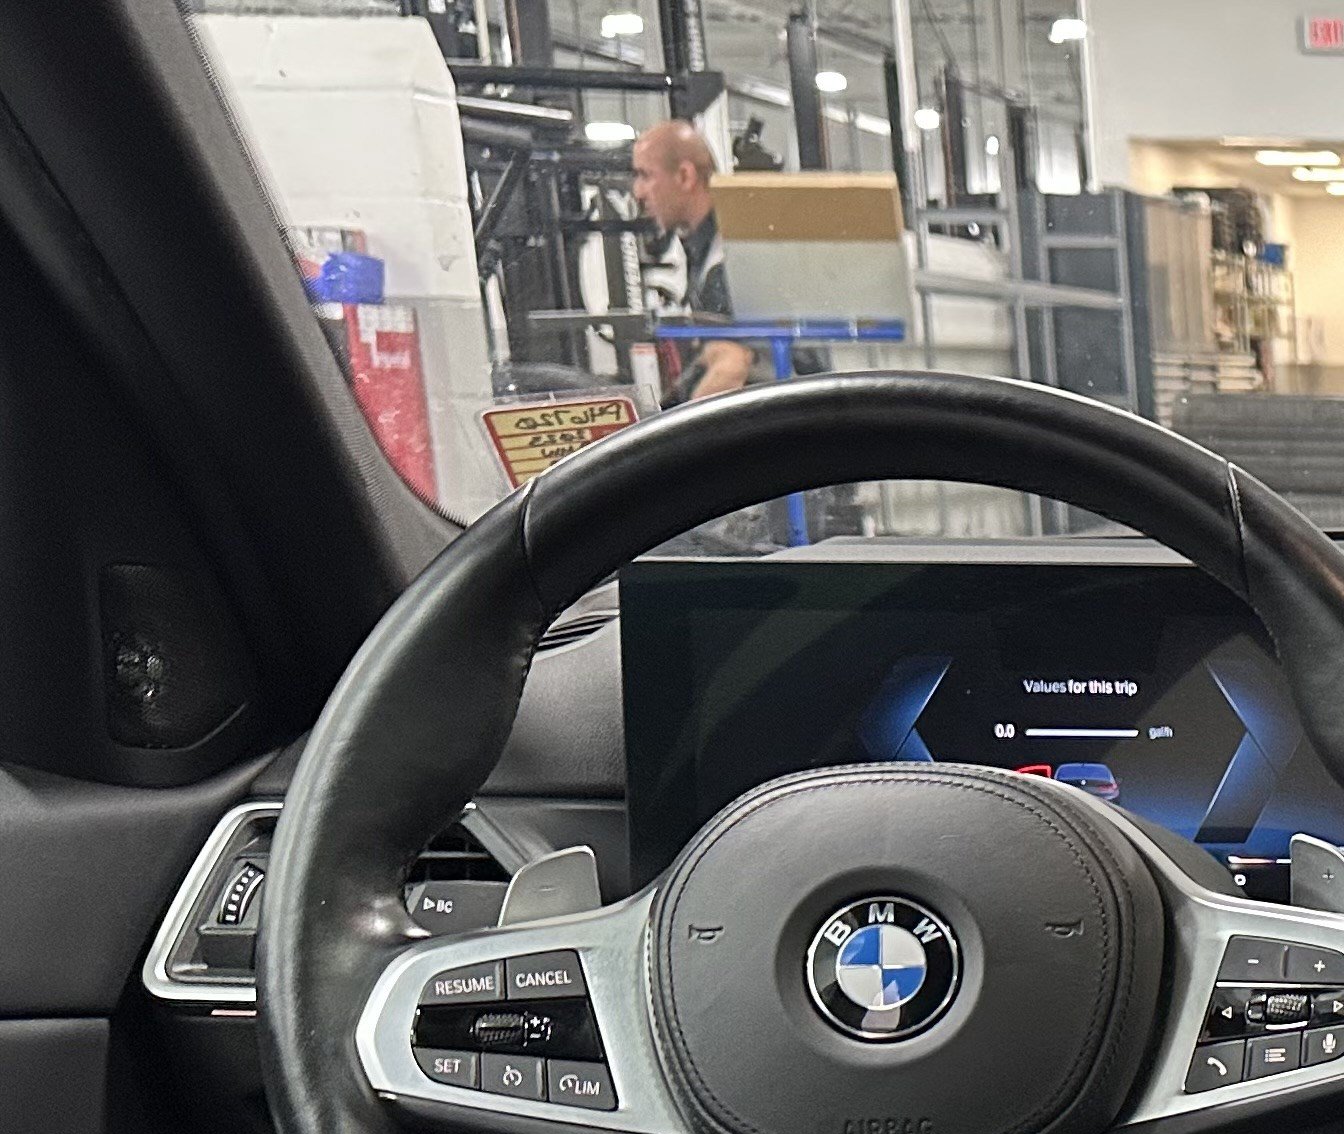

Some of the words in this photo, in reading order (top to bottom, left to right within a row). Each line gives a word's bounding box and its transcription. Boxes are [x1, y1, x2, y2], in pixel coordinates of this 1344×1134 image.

[1023, 679, 1067, 694] Values
[1067, 679, 1086, 694] for
[1089, 680, 1113, 695] this
[1115, 680, 1138, 697] trip
[994, 723, 1016, 739] 0.0
[824, 902, 943, 947] BMW
[435, 975, 495, 997] RESUME
[515, 969, 573, 989] CANCEL
[434, 1057, 462, 1075] SET
[574, 1079, 601, 1097] LIM
